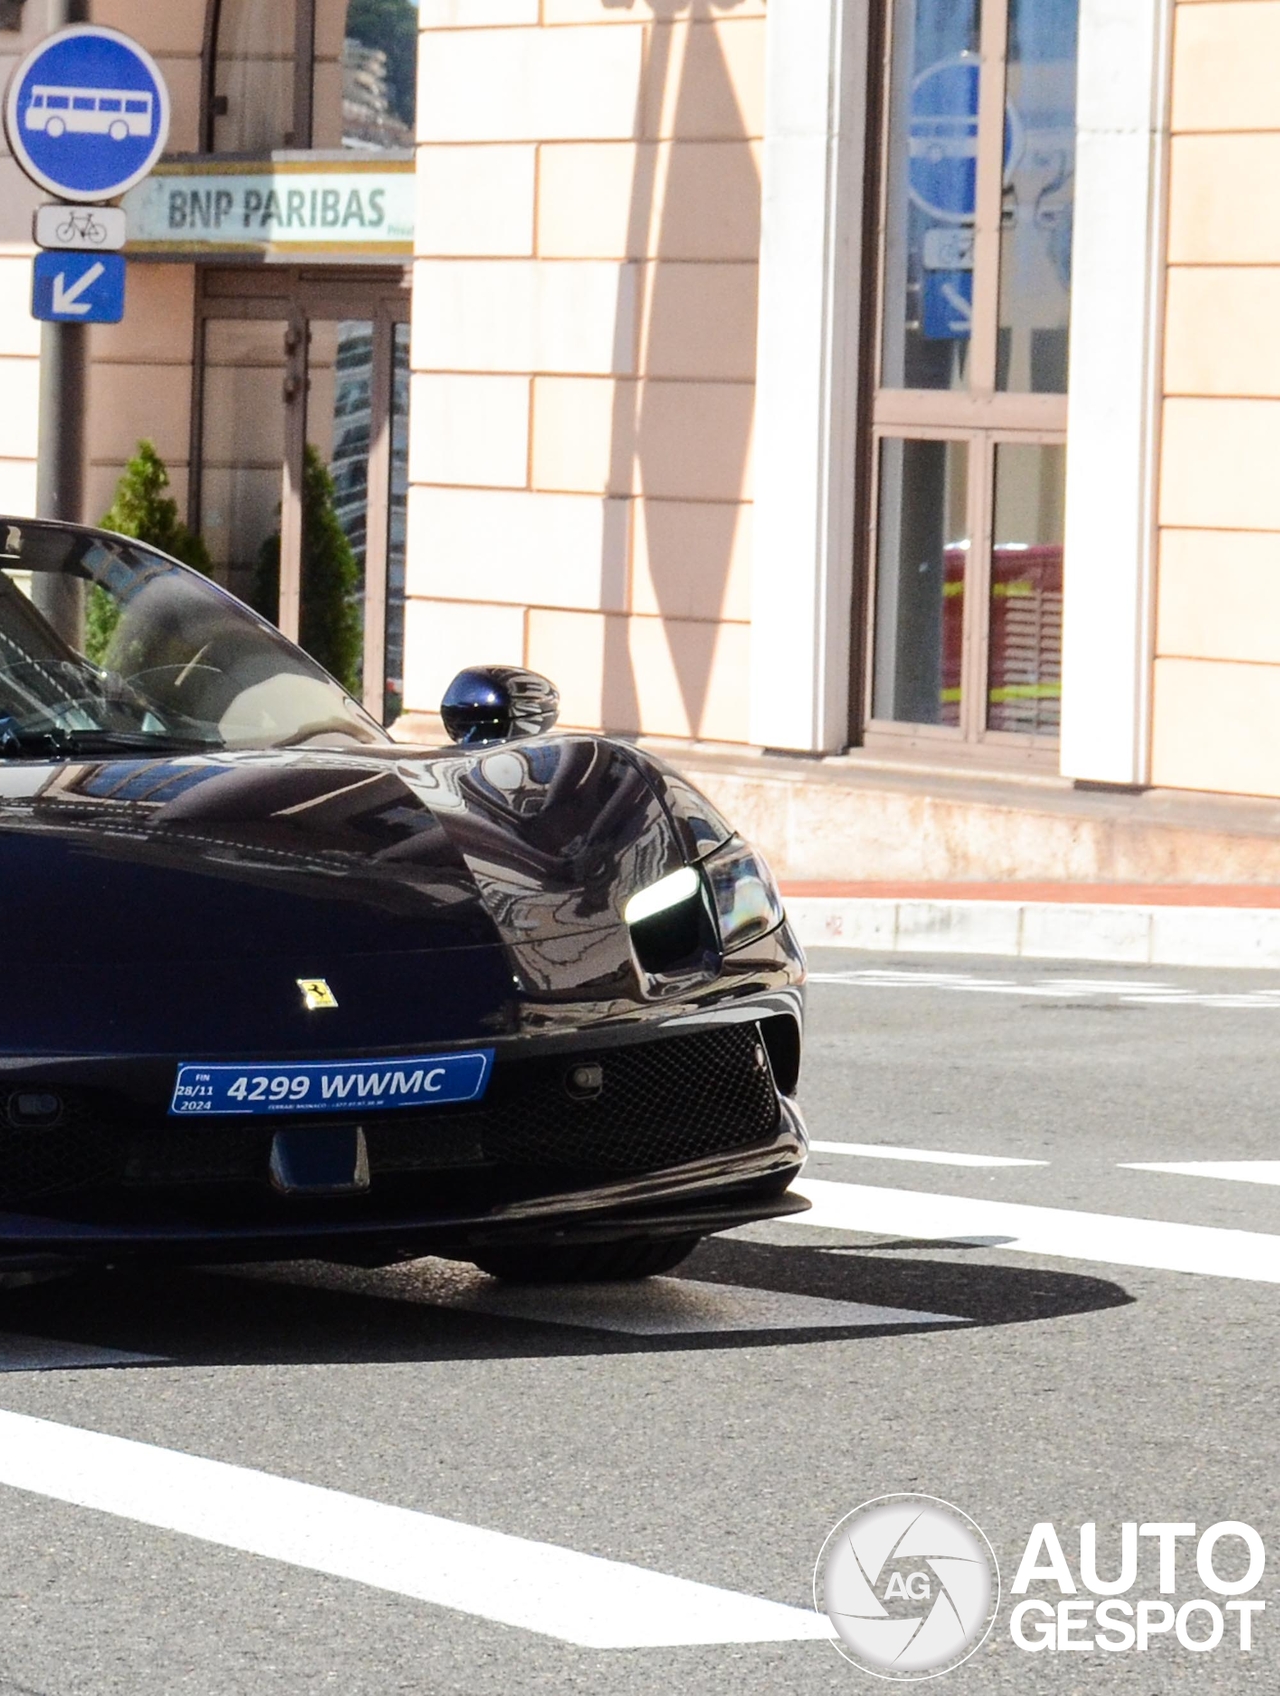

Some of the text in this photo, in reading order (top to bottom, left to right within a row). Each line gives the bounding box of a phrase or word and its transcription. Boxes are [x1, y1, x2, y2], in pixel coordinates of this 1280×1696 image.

[169, 188, 385, 228] BNP PARIBAS
[177, 1085, 213, 1097] 28/11
[227, 1068, 446, 1101] 4299 WWMC
[180, 1101, 212, 1110] 2024
